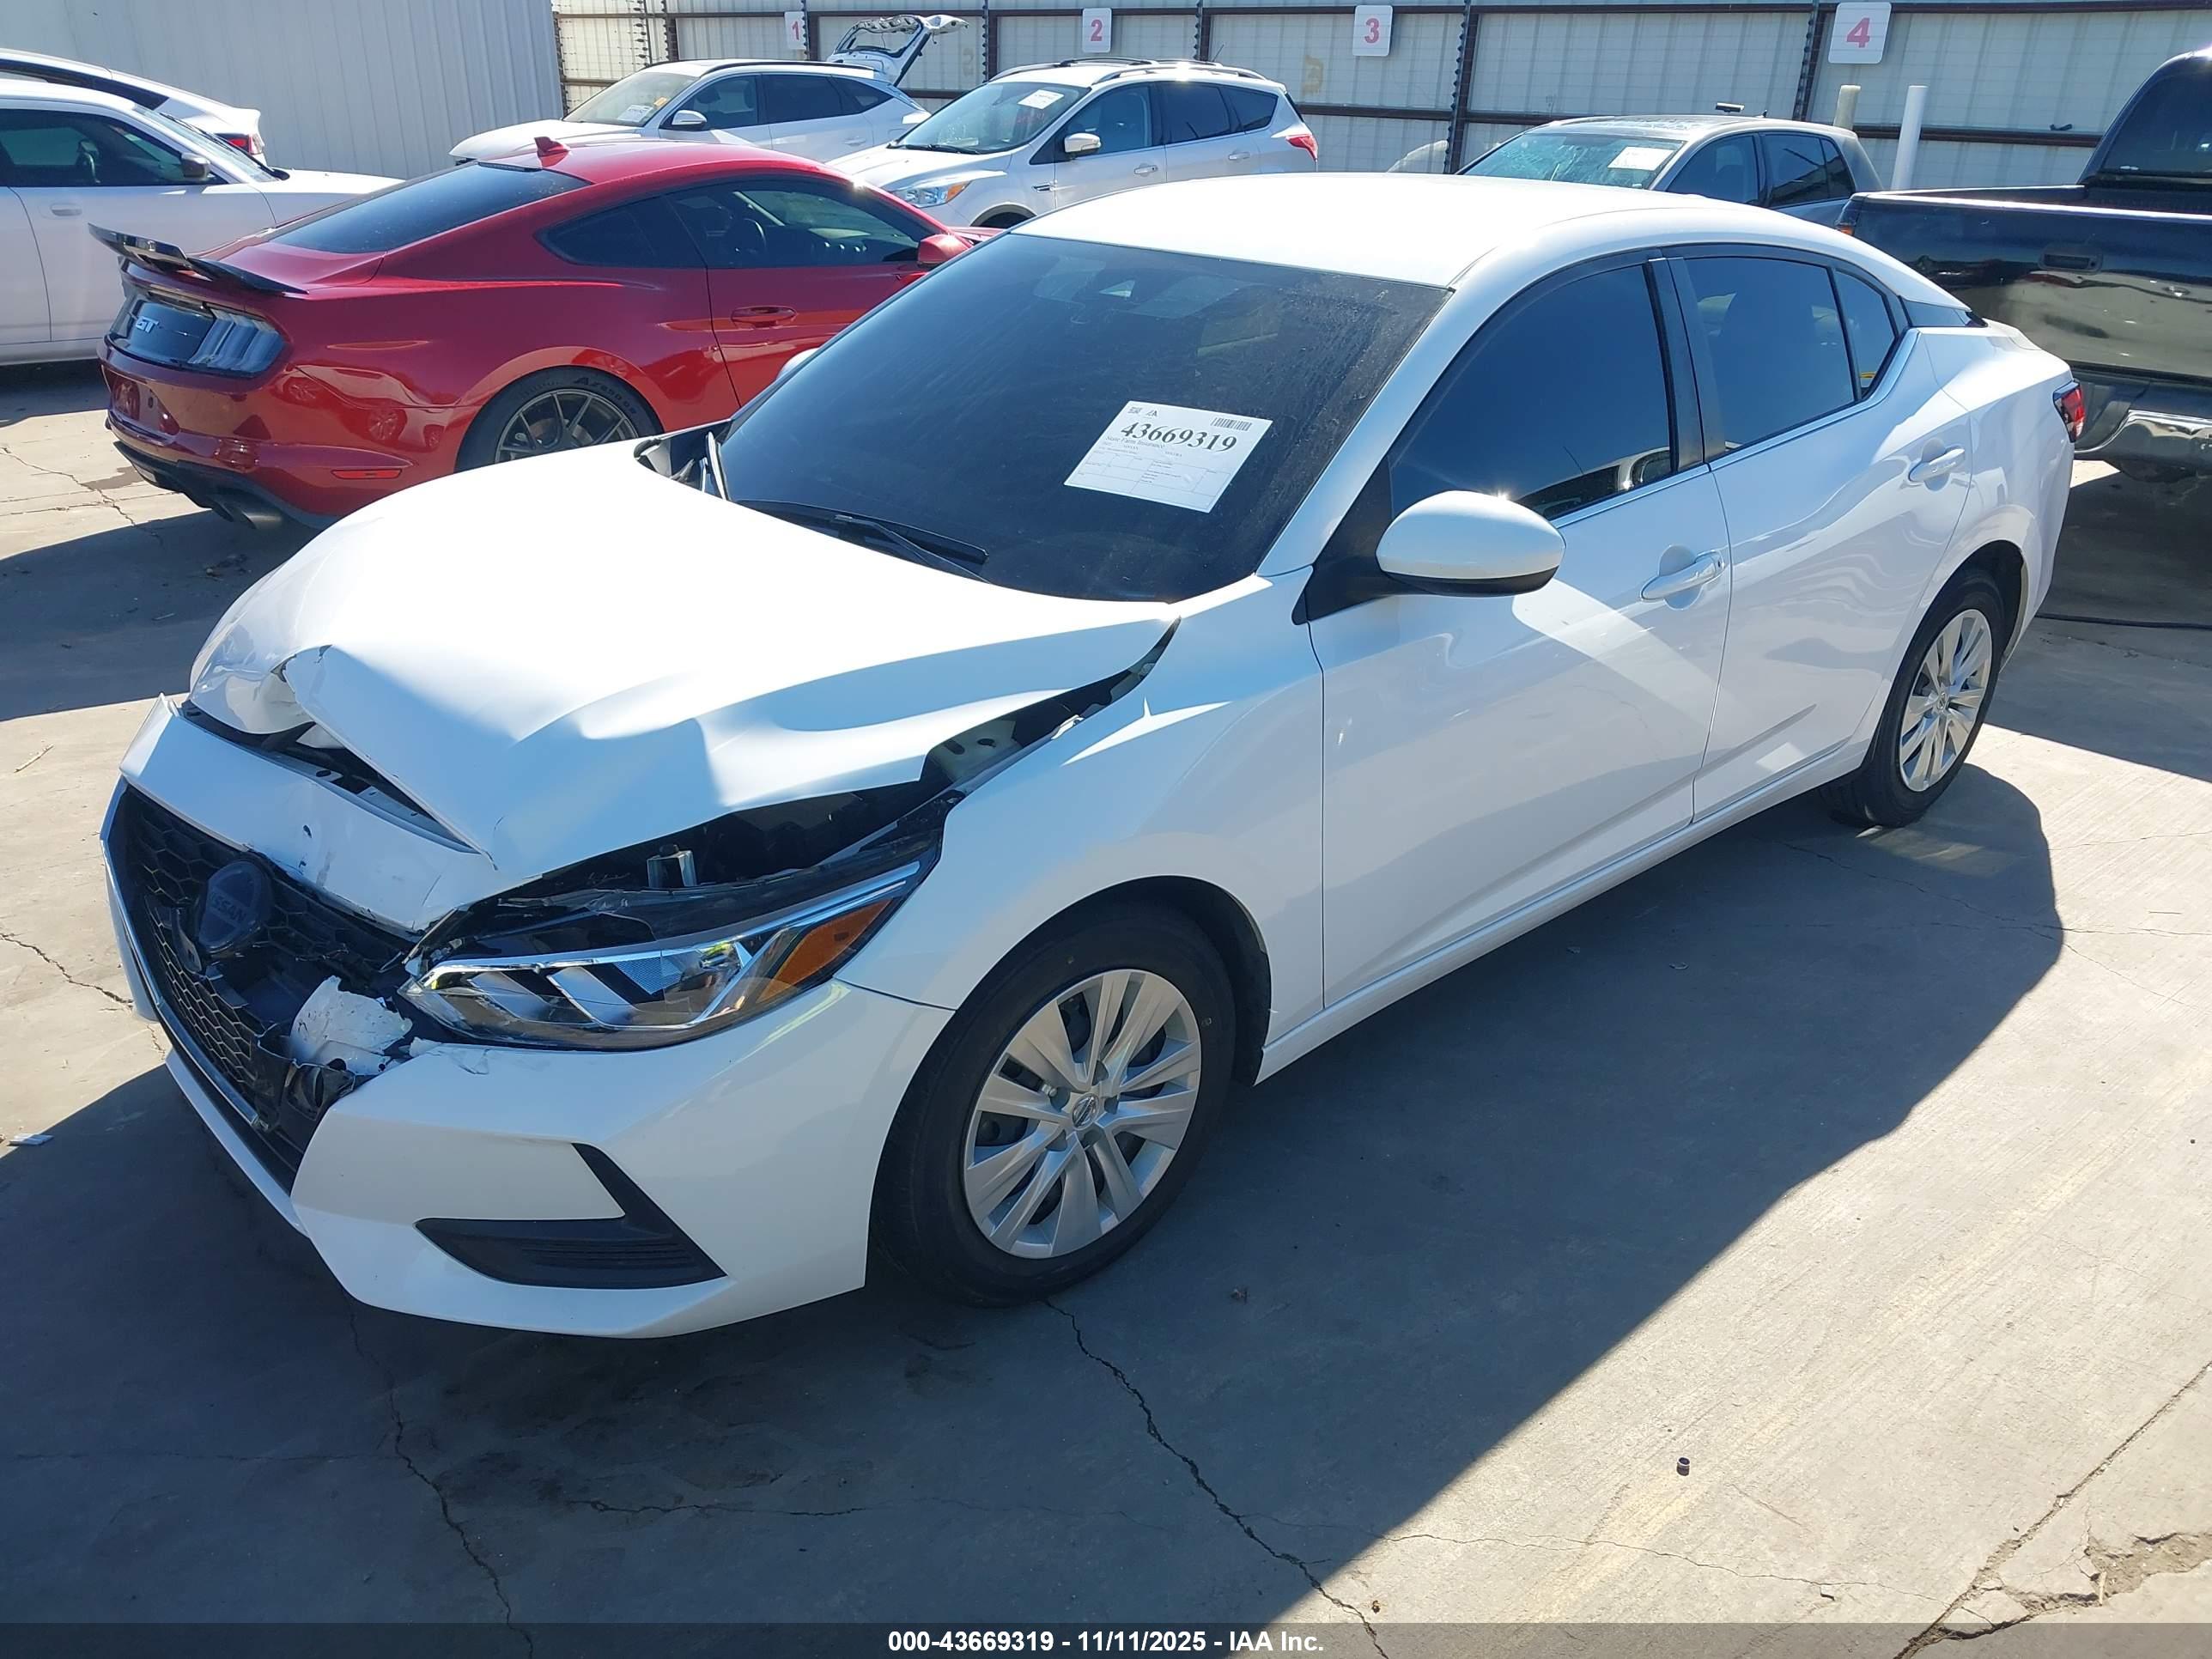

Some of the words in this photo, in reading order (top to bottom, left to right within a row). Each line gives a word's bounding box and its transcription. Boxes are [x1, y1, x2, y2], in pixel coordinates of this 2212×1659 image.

[792, 21, 799, 40] 1
[1091, 19, 1103, 42] 2
[1364, 17, 1380, 44] 3
[1846, 17, 1870, 48] 4
[136, 315, 159, 333] GT
[1121, 422, 1237, 453] 43669319
